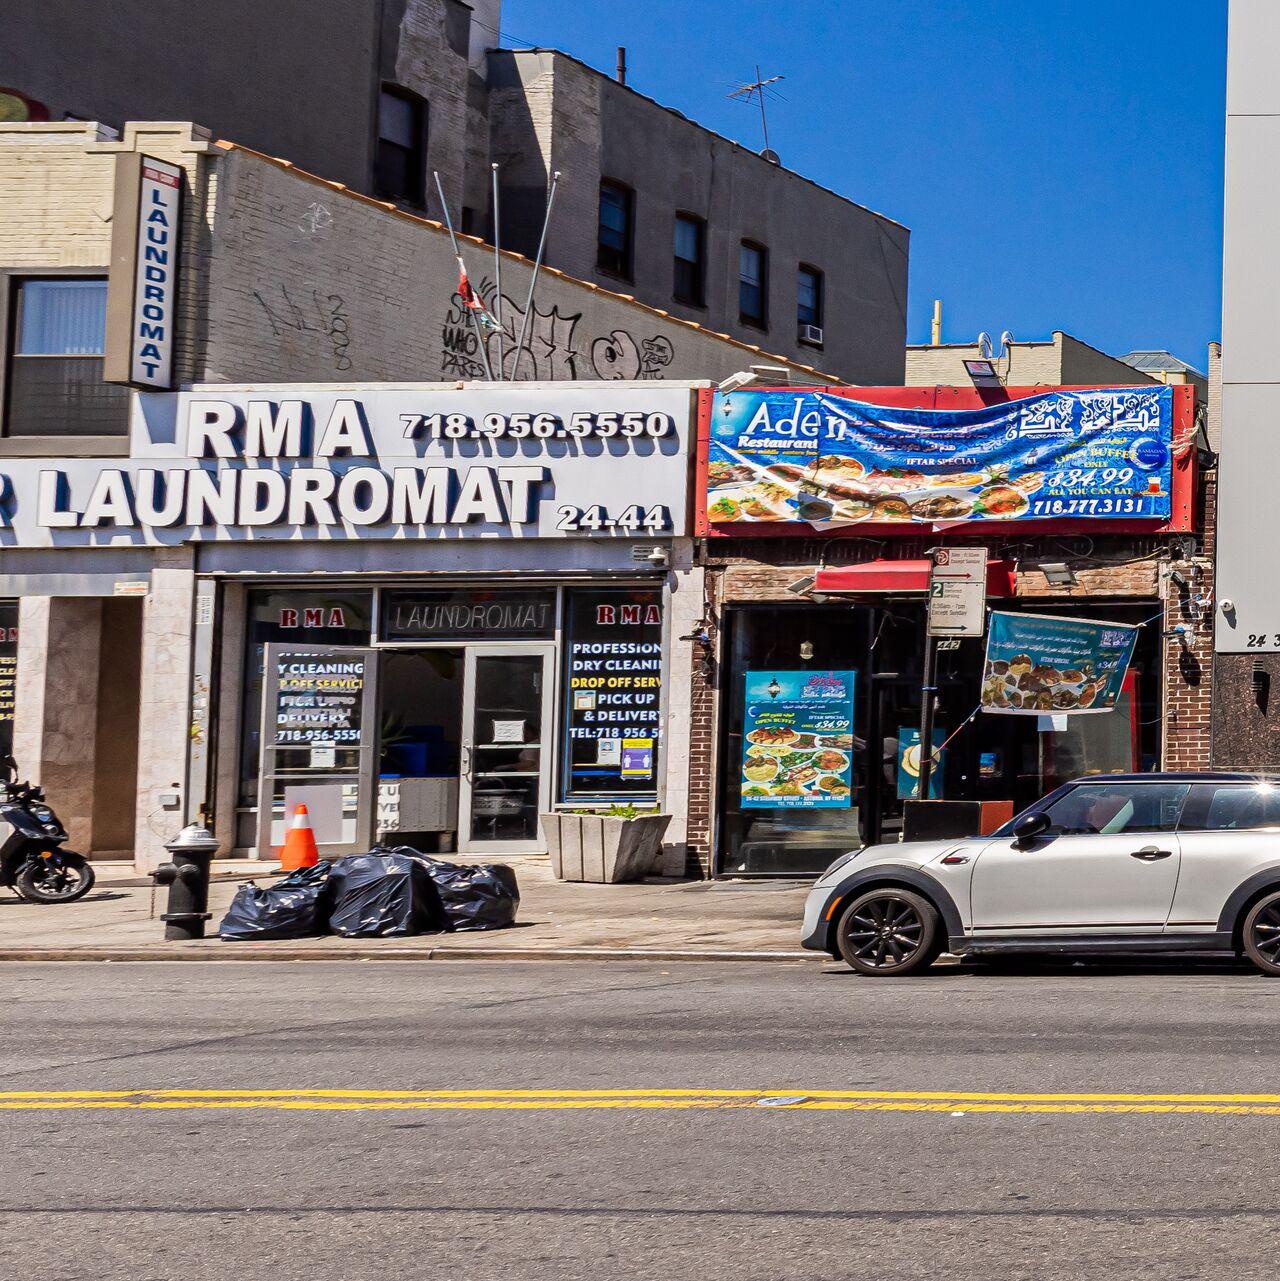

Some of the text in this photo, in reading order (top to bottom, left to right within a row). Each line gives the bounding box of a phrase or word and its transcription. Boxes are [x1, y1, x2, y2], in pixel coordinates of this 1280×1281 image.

[139, 189, 169, 378] LAUNDROMAT
[399, 412, 669, 438] 718.956.5550
[741, 397, 847, 442] Aden
[186, 400, 374, 458] RMA
[737, 436, 819, 449] Restaurant
[906, 457, 978, 465] IFTAR SPECIAL
[37, 466, 546, 527] LAUNDROMAT
[1114, 487, 1133, 495] EAT
[1033, 498, 1143, 515] 718.777.3131
[556, 505, 665, 531] 24-44
[933, 583, 942, 597] 2
[280, 608, 345, 628] RMA
[395, 604, 551, 629] LAUNDROMAT
[597, 605, 661, 625] RMA
[289, 663, 364, 674] CLEANING
[573, 660, 603, 670] DRY
[571, 677, 605, 688] DROP
[607, 677, 632, 688] OFF
[598, 694, 655, 704] PICK UP
[584, 710, 595, 721] &
[814, 720, 850, 729] $34.99
